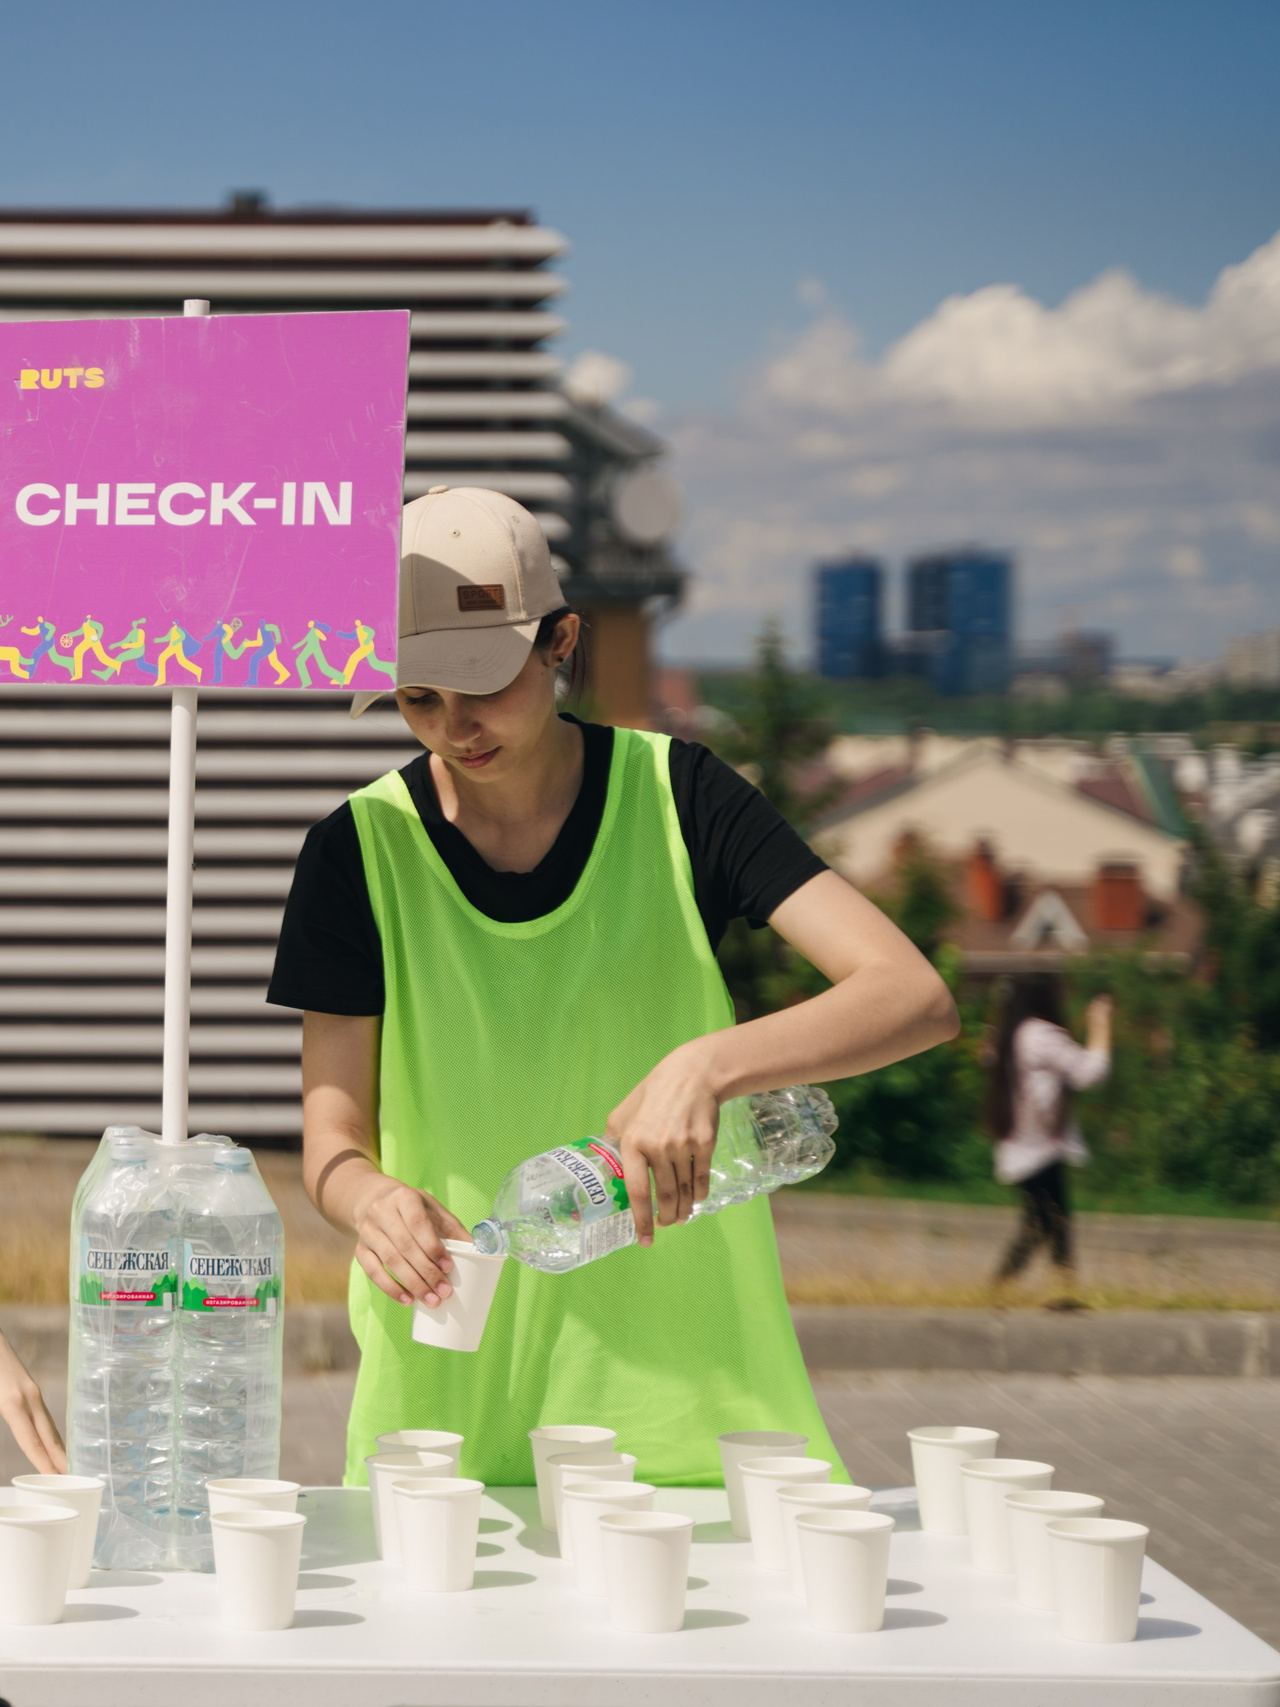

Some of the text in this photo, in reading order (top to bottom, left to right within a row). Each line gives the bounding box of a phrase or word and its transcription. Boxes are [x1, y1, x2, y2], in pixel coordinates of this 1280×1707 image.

[19, 367, 105, 390] RUTS
[16, 481, 354, 527] CHECK-IN
[463, 588, 498, 600] SPORT
[547, 1148, 607, 1205] СЕНЕЖСКАЯ
[87, 1250, 169, 1271] СЕНЕЖСКАЯ
[190, 1257, 273, 1276] СЕНЕЖСКАЯ
